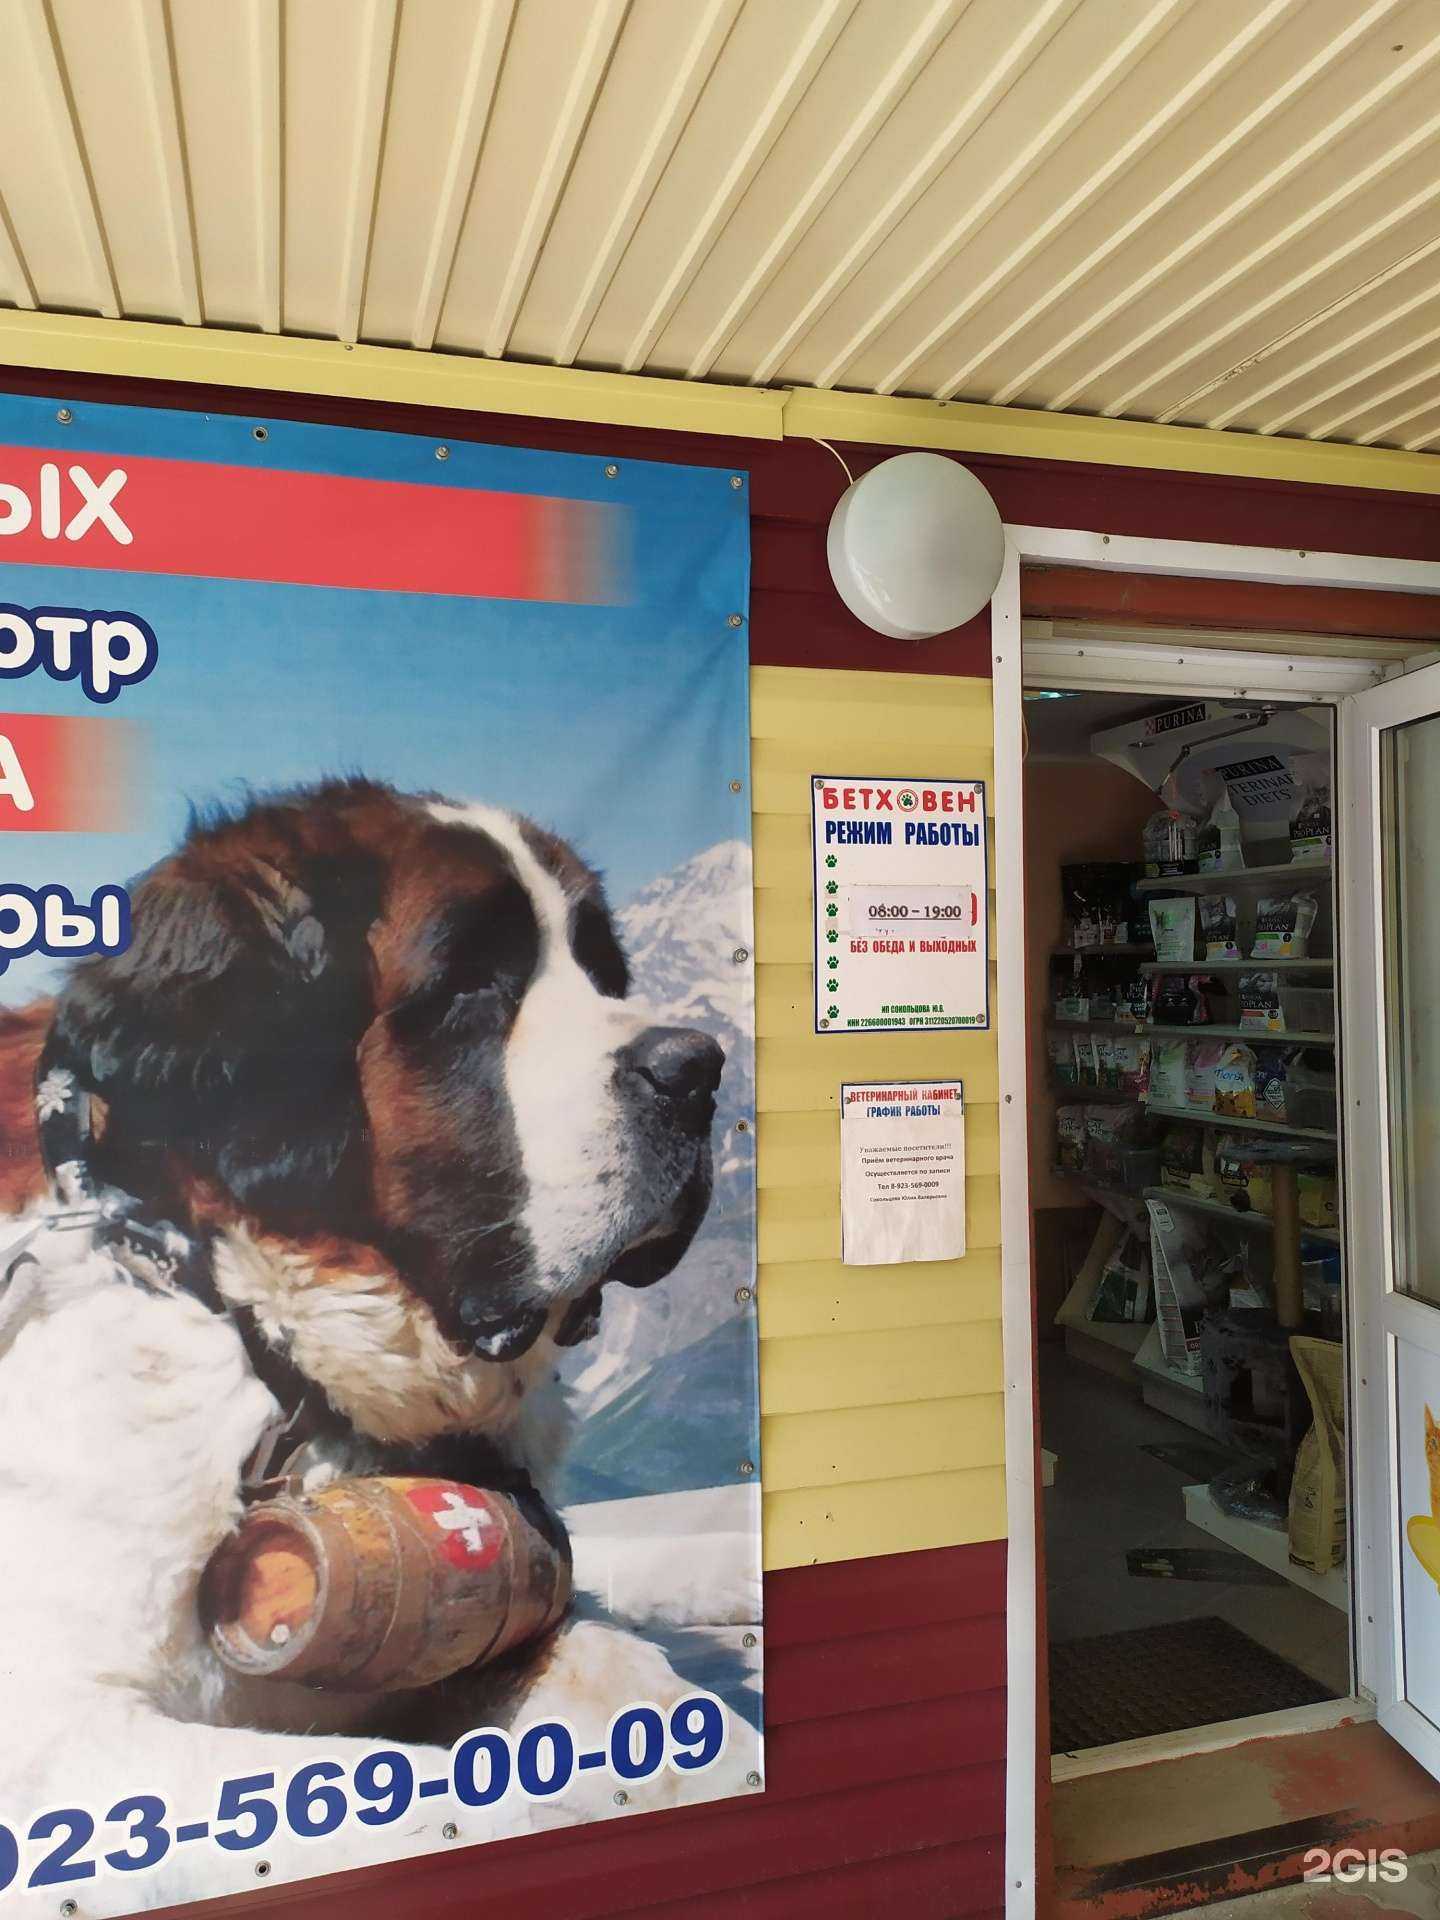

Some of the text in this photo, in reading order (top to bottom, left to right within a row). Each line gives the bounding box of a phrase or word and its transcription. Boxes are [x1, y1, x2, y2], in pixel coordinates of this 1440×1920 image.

[1156, 704, 1206, 732] PURINA
[1220, 757, 1282, 780] PURINA
[1242, 787, 1293, 807] DIETS
[825, 820, 980, 847] РЕЖИМ РАБОТЫ
[868, 904, 909, 919] 08:00
[924, 905, 962, 919] 19:00
[850, 939, 977, 954] БЕЗ ОБЕДА И ВЫХОДНЫХ
[881, 1005, 890, 1014] ИП
[890, 1004, 931, 1014] СОКОЛЬЦОВА
[847, 1018, 860, 1027] ИНН
[909, 1016, 924, 1026] ОГРН
[850, 1088, 958, 1103] ВЕТЕРИНАРНЫЙ КАБИНЕТ
[866, 1104, 941, 1118] ГРАФИК РАБОТЫ
[859, 1143, 952, 1154] Уважаемые посетители!!!
[885, 1155, 935, 1164] ветеринарного
[935, 1154, 954, 1162] врача
[865, 1169, 918, 1178] Осуществляется
[890, 1181, 940, 1190] 8-923-569-0009
